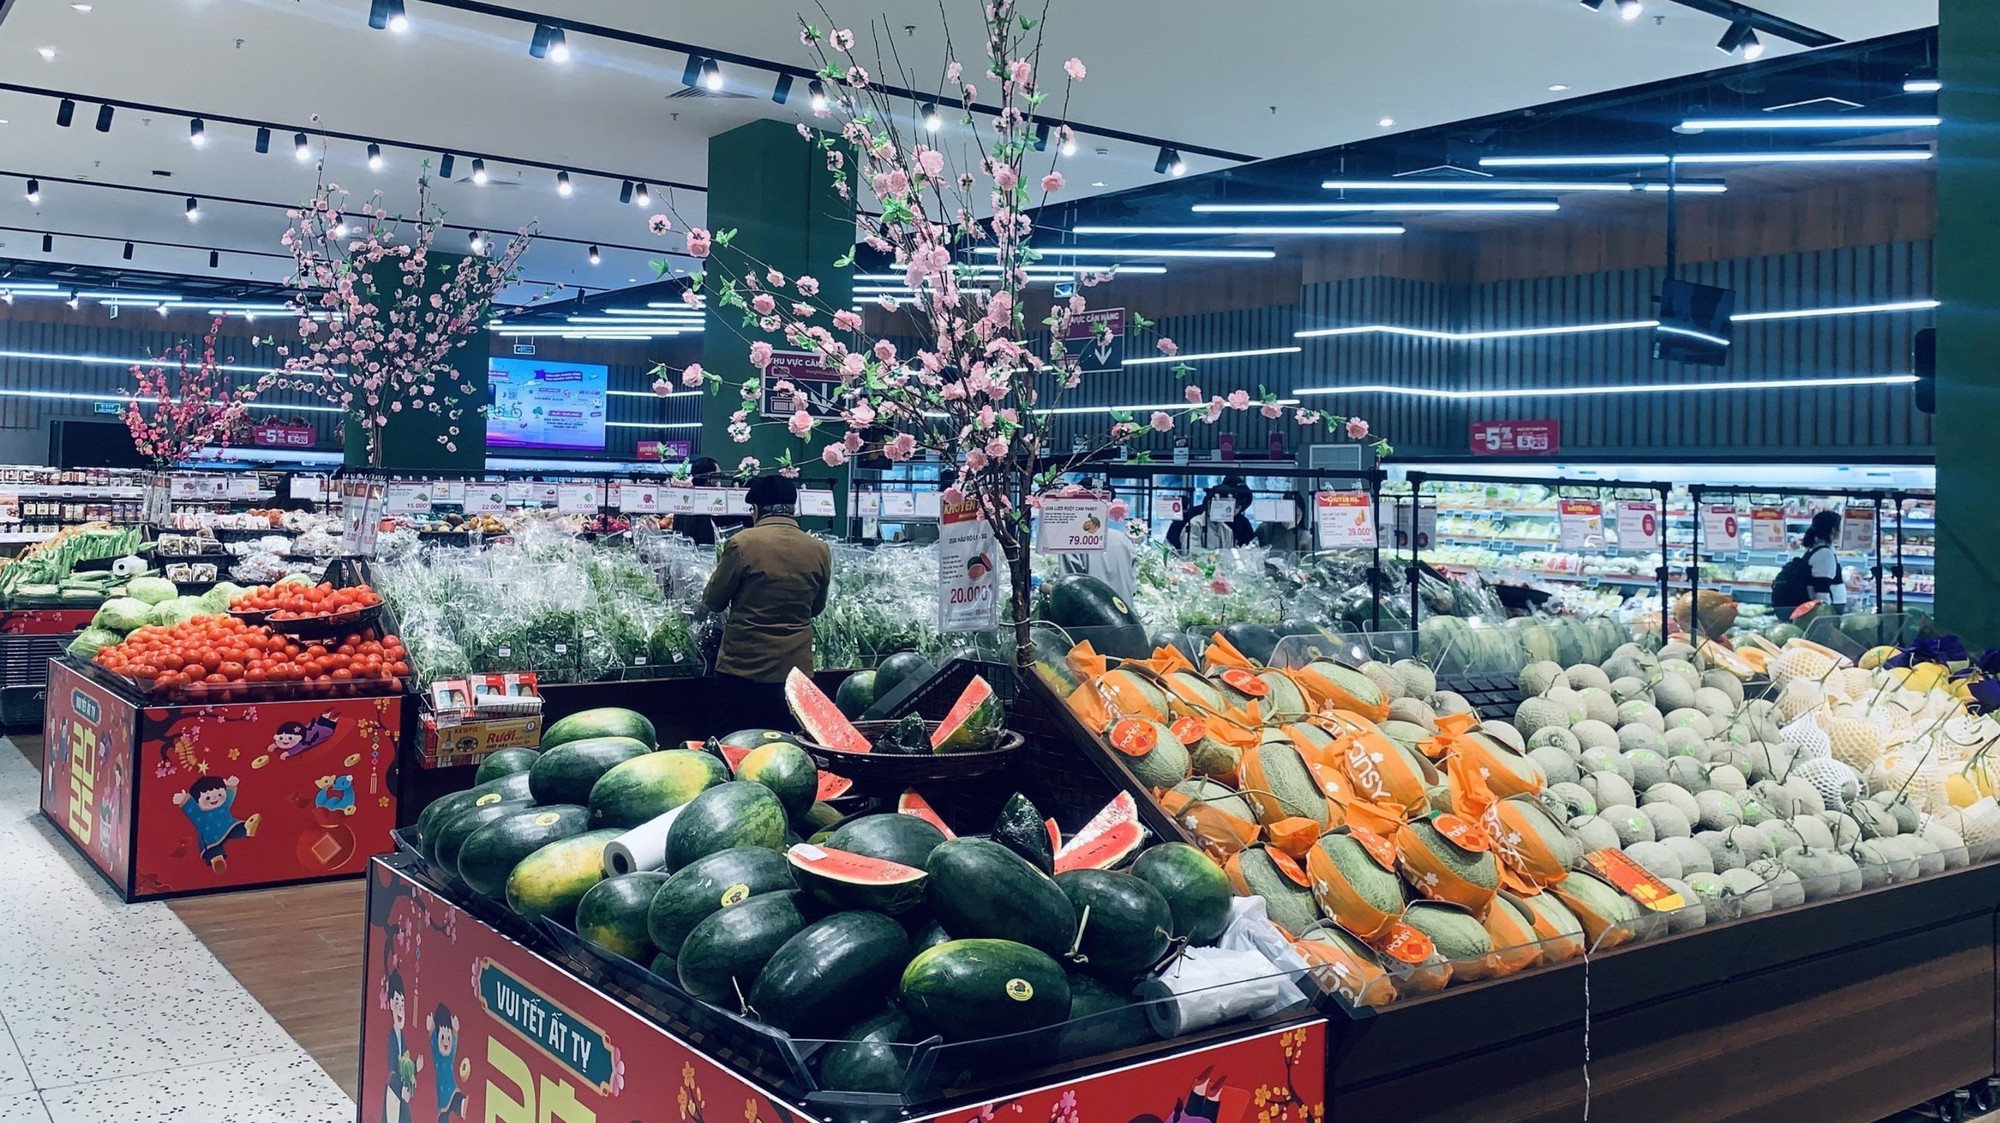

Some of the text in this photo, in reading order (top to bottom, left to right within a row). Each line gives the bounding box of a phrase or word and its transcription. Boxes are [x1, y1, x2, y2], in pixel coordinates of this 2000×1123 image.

[787, 358, 804, 368] VỰC
[71, 721, 97, 790] 20
[69, 775, 94, 846] 25
[496, 981, 592, 1073] VUI TẾT ẤT TỴ
